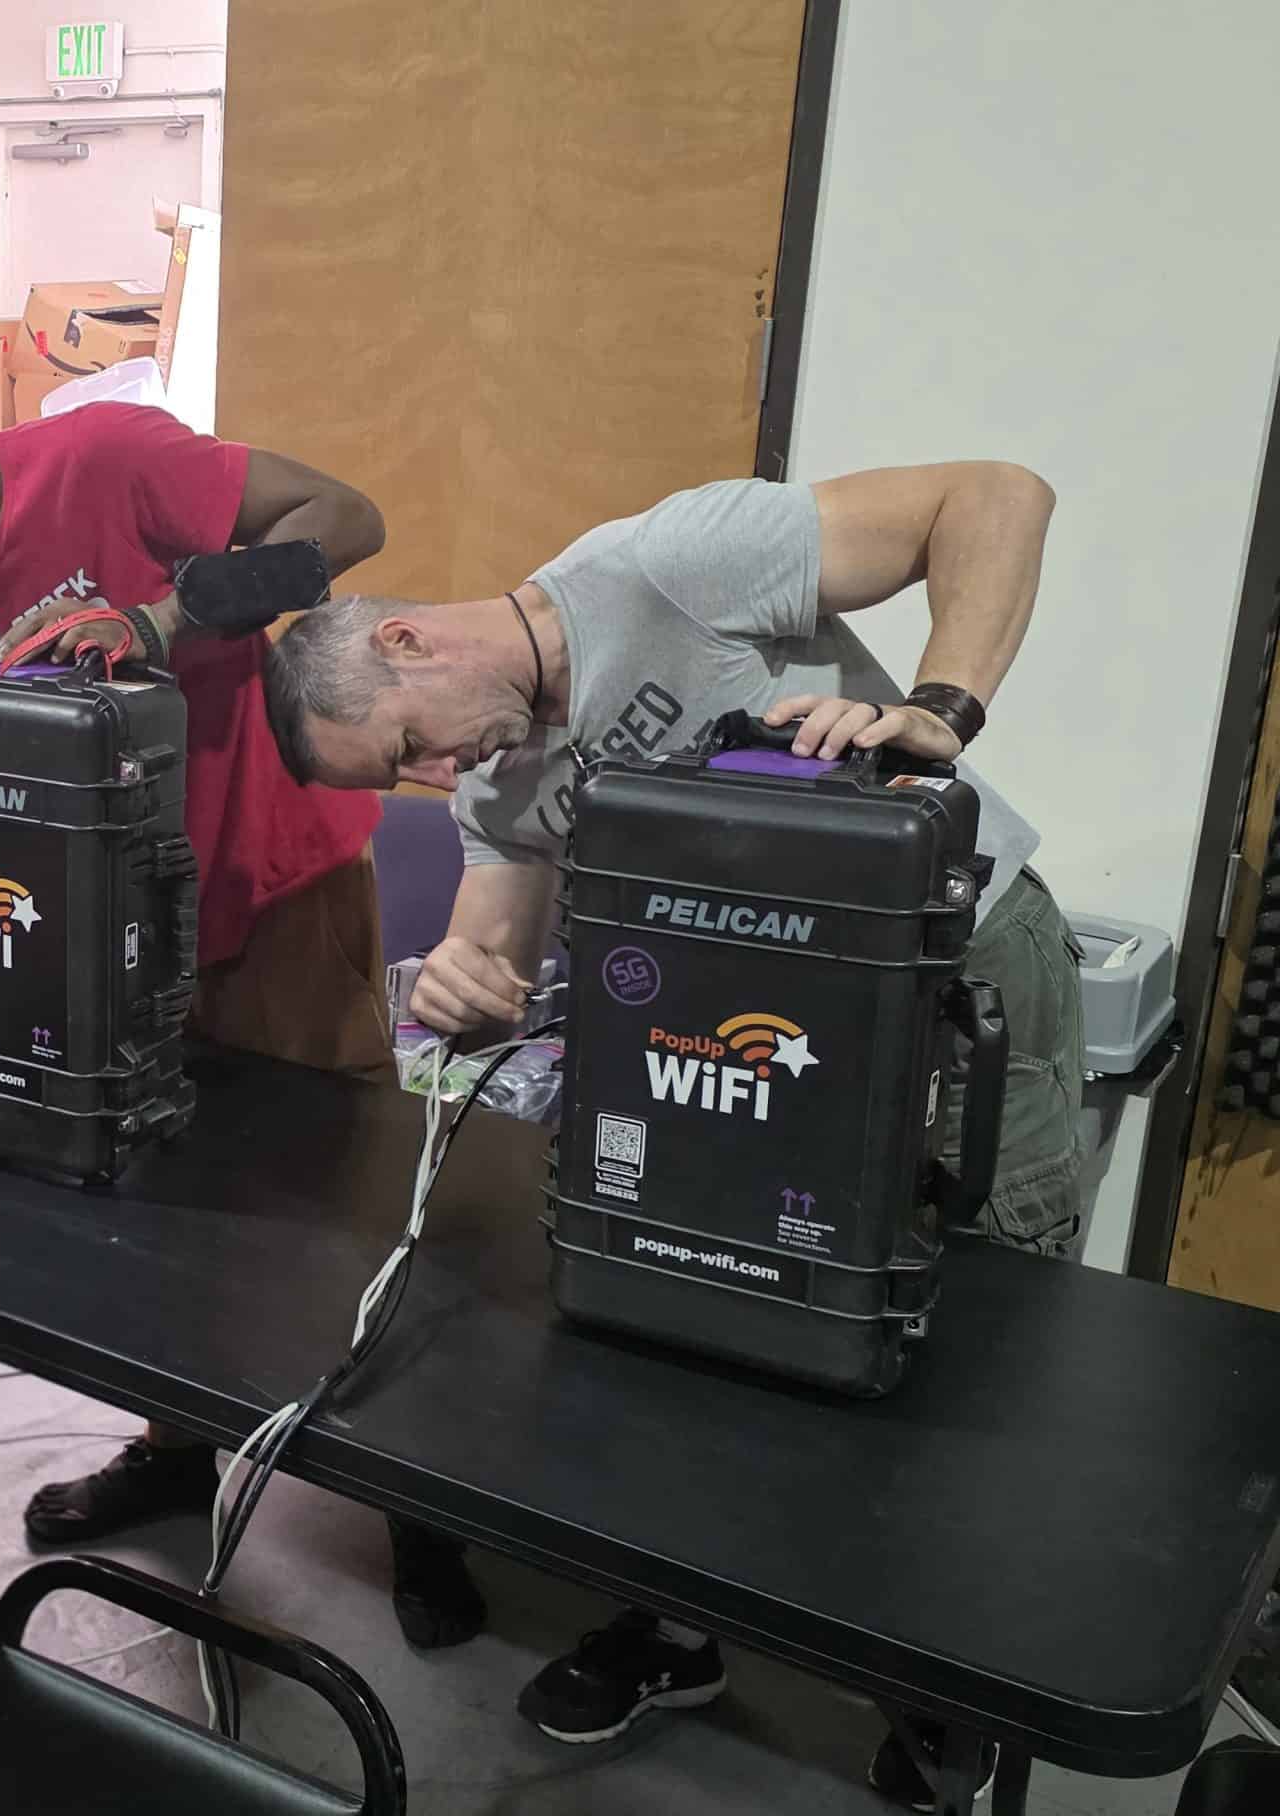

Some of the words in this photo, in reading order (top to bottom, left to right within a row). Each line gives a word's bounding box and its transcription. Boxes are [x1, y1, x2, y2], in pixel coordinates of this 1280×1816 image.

[58, 24, 106, 76] EXIT
[645, 894, 816, 943] PELICAN
[610, 957, 649, 985] 5G
[649, 1026, 726, 1060] PopUp
[645, 1050, 771, 1121] WiFi
[633, 1235, 781, 1282] popup-wifi.com
